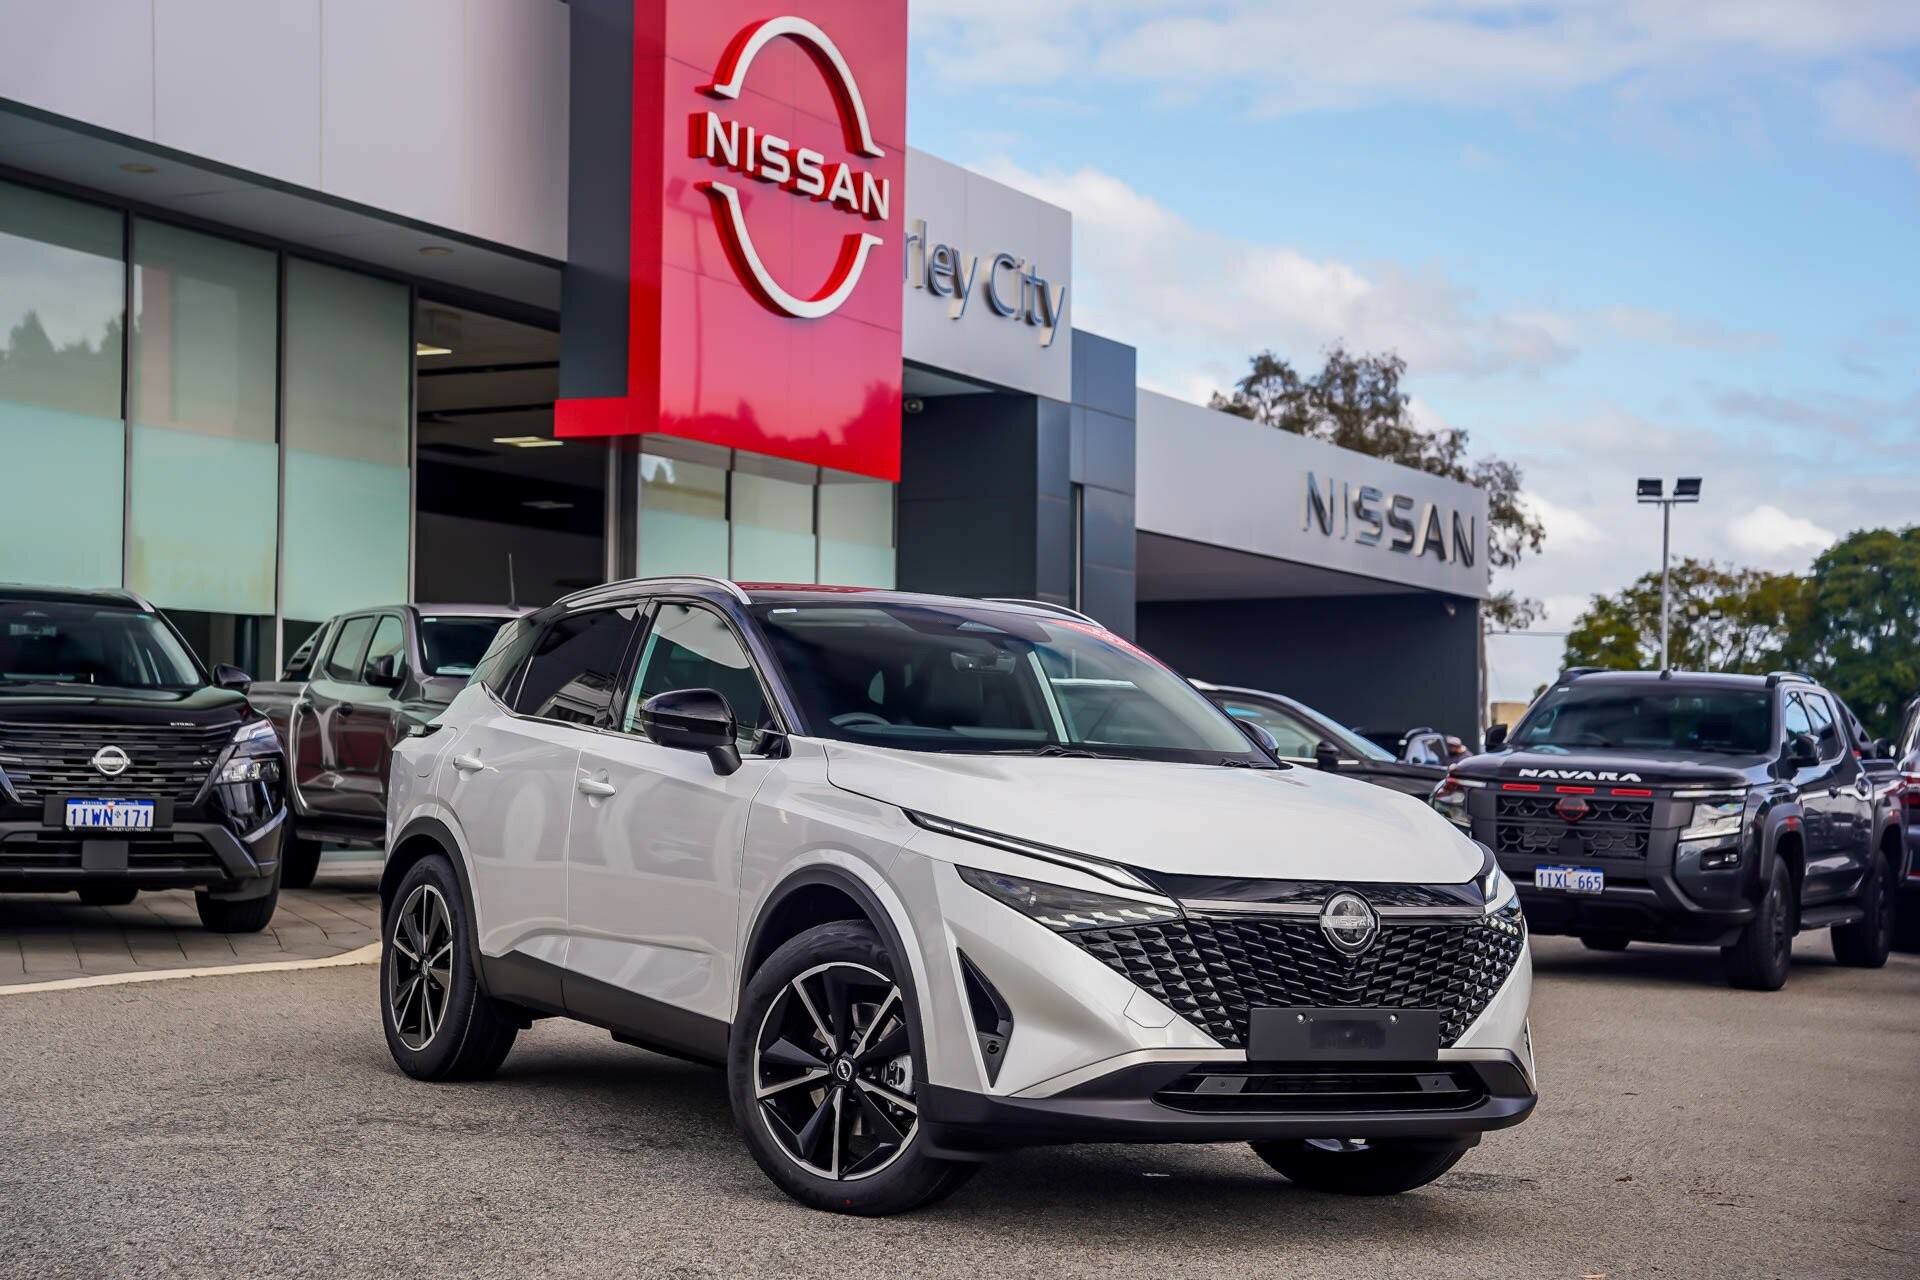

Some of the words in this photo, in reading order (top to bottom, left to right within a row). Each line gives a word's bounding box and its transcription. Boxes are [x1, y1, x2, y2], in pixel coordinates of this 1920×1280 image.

[704, 111, 890, 221] NISSAN
[984, 252, 1067, 348] City
[1303, 471, 1475, 568] NISSAN
[1518, 768, 1642, 783] NAVARA
[71, 808, 113, 826] 1IWN
[123, 809, 150, 828] 171
[1539, 872, 1572, 889] 1IXL
[1578, 875, 1602, 891] 665
[1321, 915, 1376, 929] NISSAN
